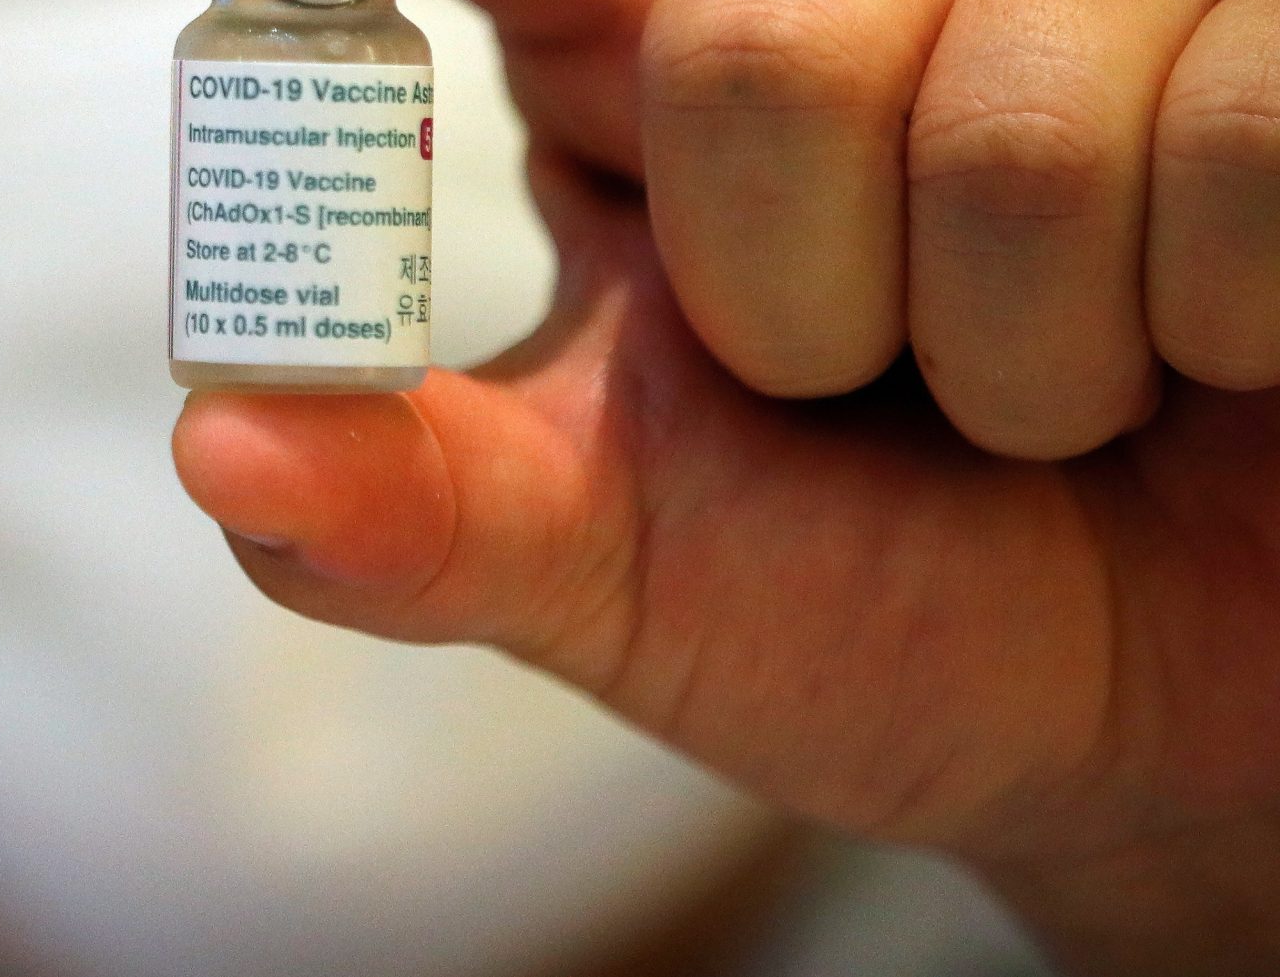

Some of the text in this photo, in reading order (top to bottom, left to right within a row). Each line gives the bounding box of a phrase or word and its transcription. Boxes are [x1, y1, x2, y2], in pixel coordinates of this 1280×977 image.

[190, 75, 433, 104] COVID-19 Vaccine Ast
[188, 122, 416, 152] Intramuscular Injection
[188, 167, 376, 192] COVID-19 Vaccine
[187, 201, 310, 225] (ChAdOx1-S
[186, 238, 230, 261] Store
[237, 242, 256, 262] at
[399, 254, 431, 285] 제조
[186, 279, 340, 306] Multidose vial
[396, 294, 431, 327] 유효
[185, 312, 392, 344] (10 x 0.5 ml doses)
